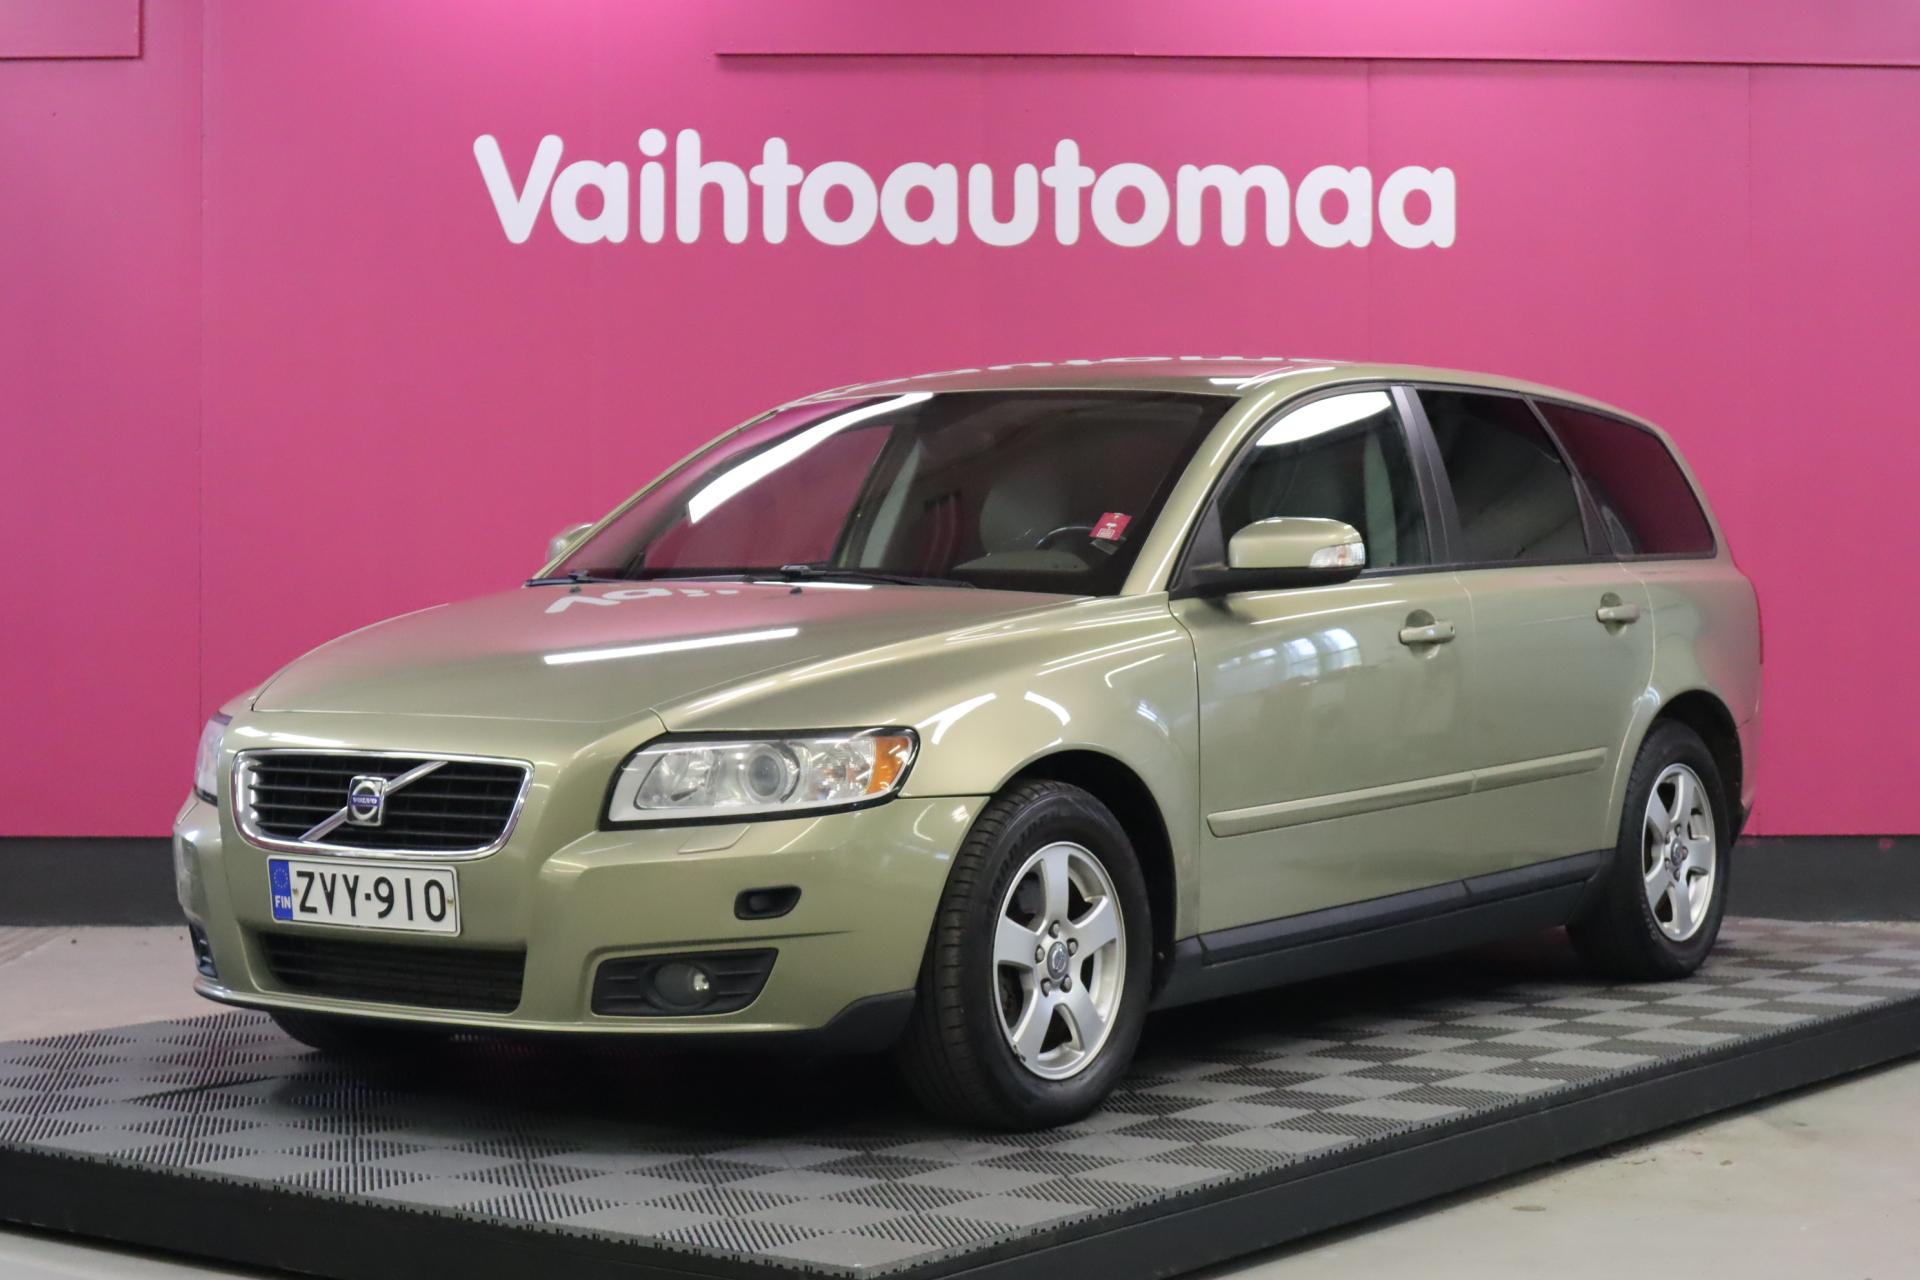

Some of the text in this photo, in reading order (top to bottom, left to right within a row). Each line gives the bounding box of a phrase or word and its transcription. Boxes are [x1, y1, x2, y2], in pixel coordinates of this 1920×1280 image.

[473, 128, 1456, 249] Vaihtoautomaa
[352, 796, 378, 805] VOLVO
[275, 895, 292, 910] FIN
[296, 870, 447, 923] ZVY-910
